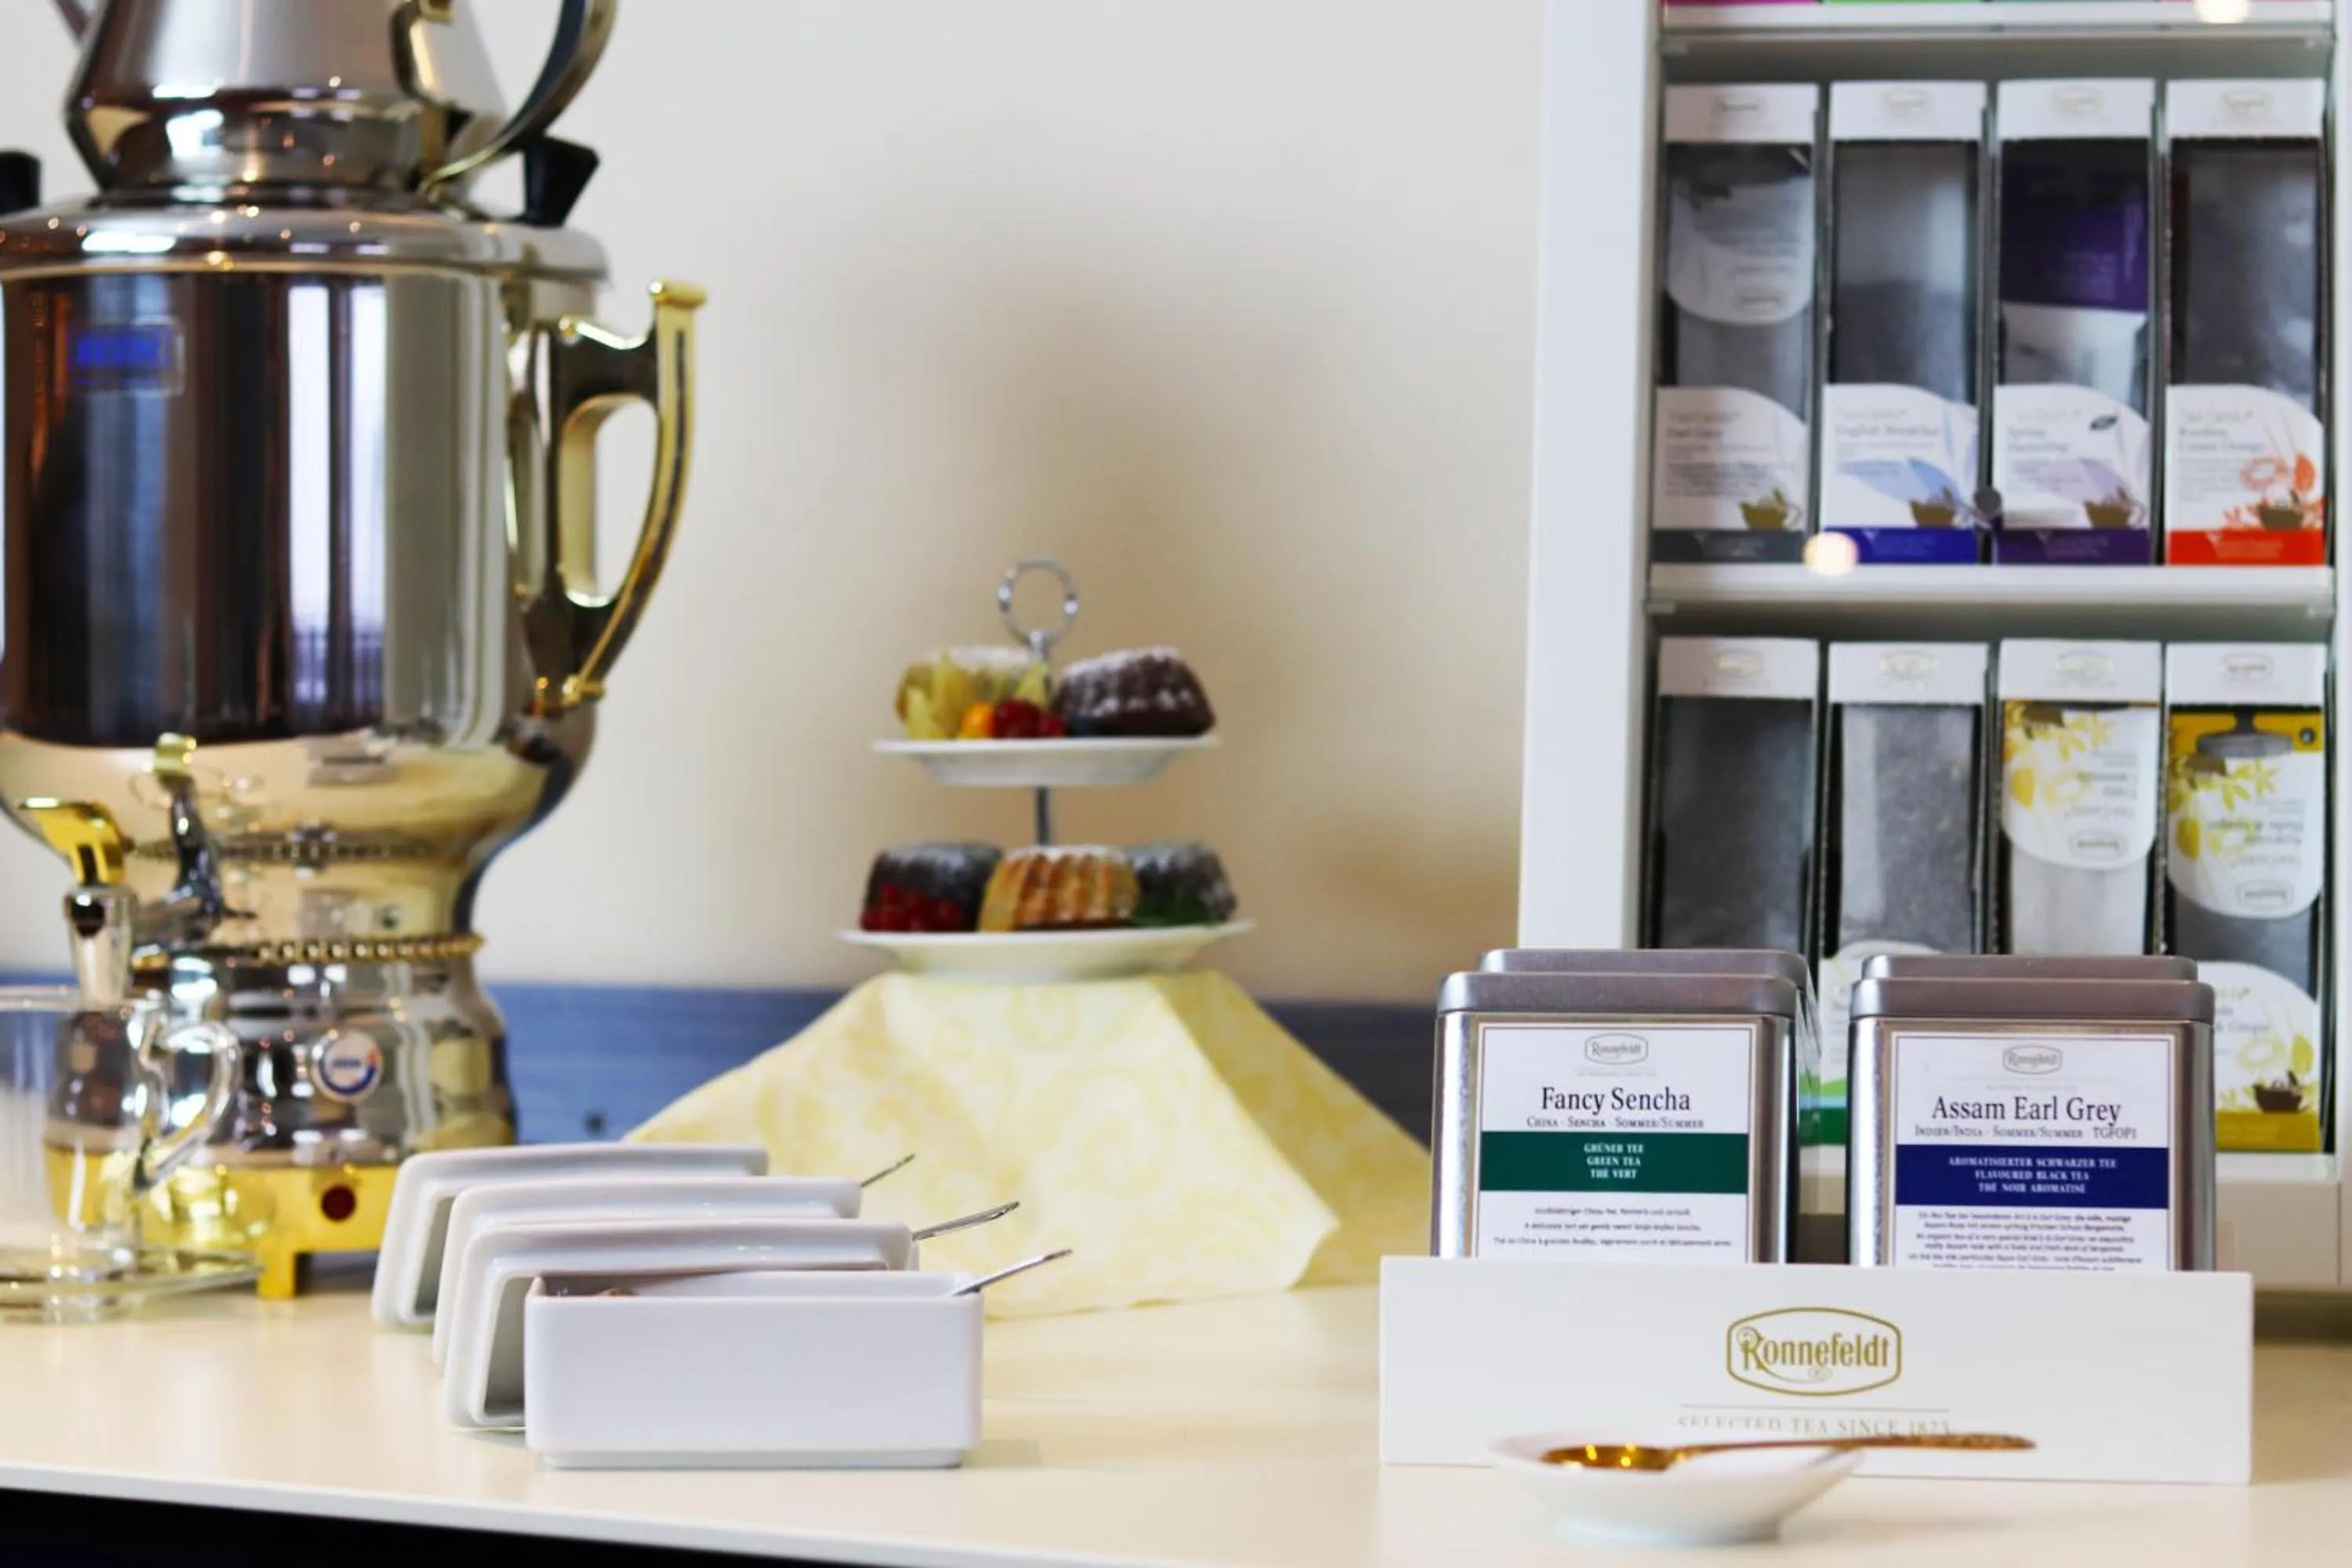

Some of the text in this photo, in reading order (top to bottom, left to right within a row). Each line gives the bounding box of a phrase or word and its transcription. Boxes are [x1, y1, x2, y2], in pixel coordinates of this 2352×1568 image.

[1541, 1086, 1690, 1116] Fancy Sencha
[1931, 1095, 2122, 1127] Assam Earl Grey
[1627, 1144, 1645, 1154] TEE
[1586, 1156, 1642, 1167] GREEN TEA
[2099, 1159, 2117, 1169] TEE
[1612, 1169, 1638, 1179] VERT
[1974, 1169, 2090, 1181] FLAVOURED BLACK TEA
[1737, 1326, 1890, 1377] Ronnefeldt
[1790, 1417, 1828, 1436] TEA
